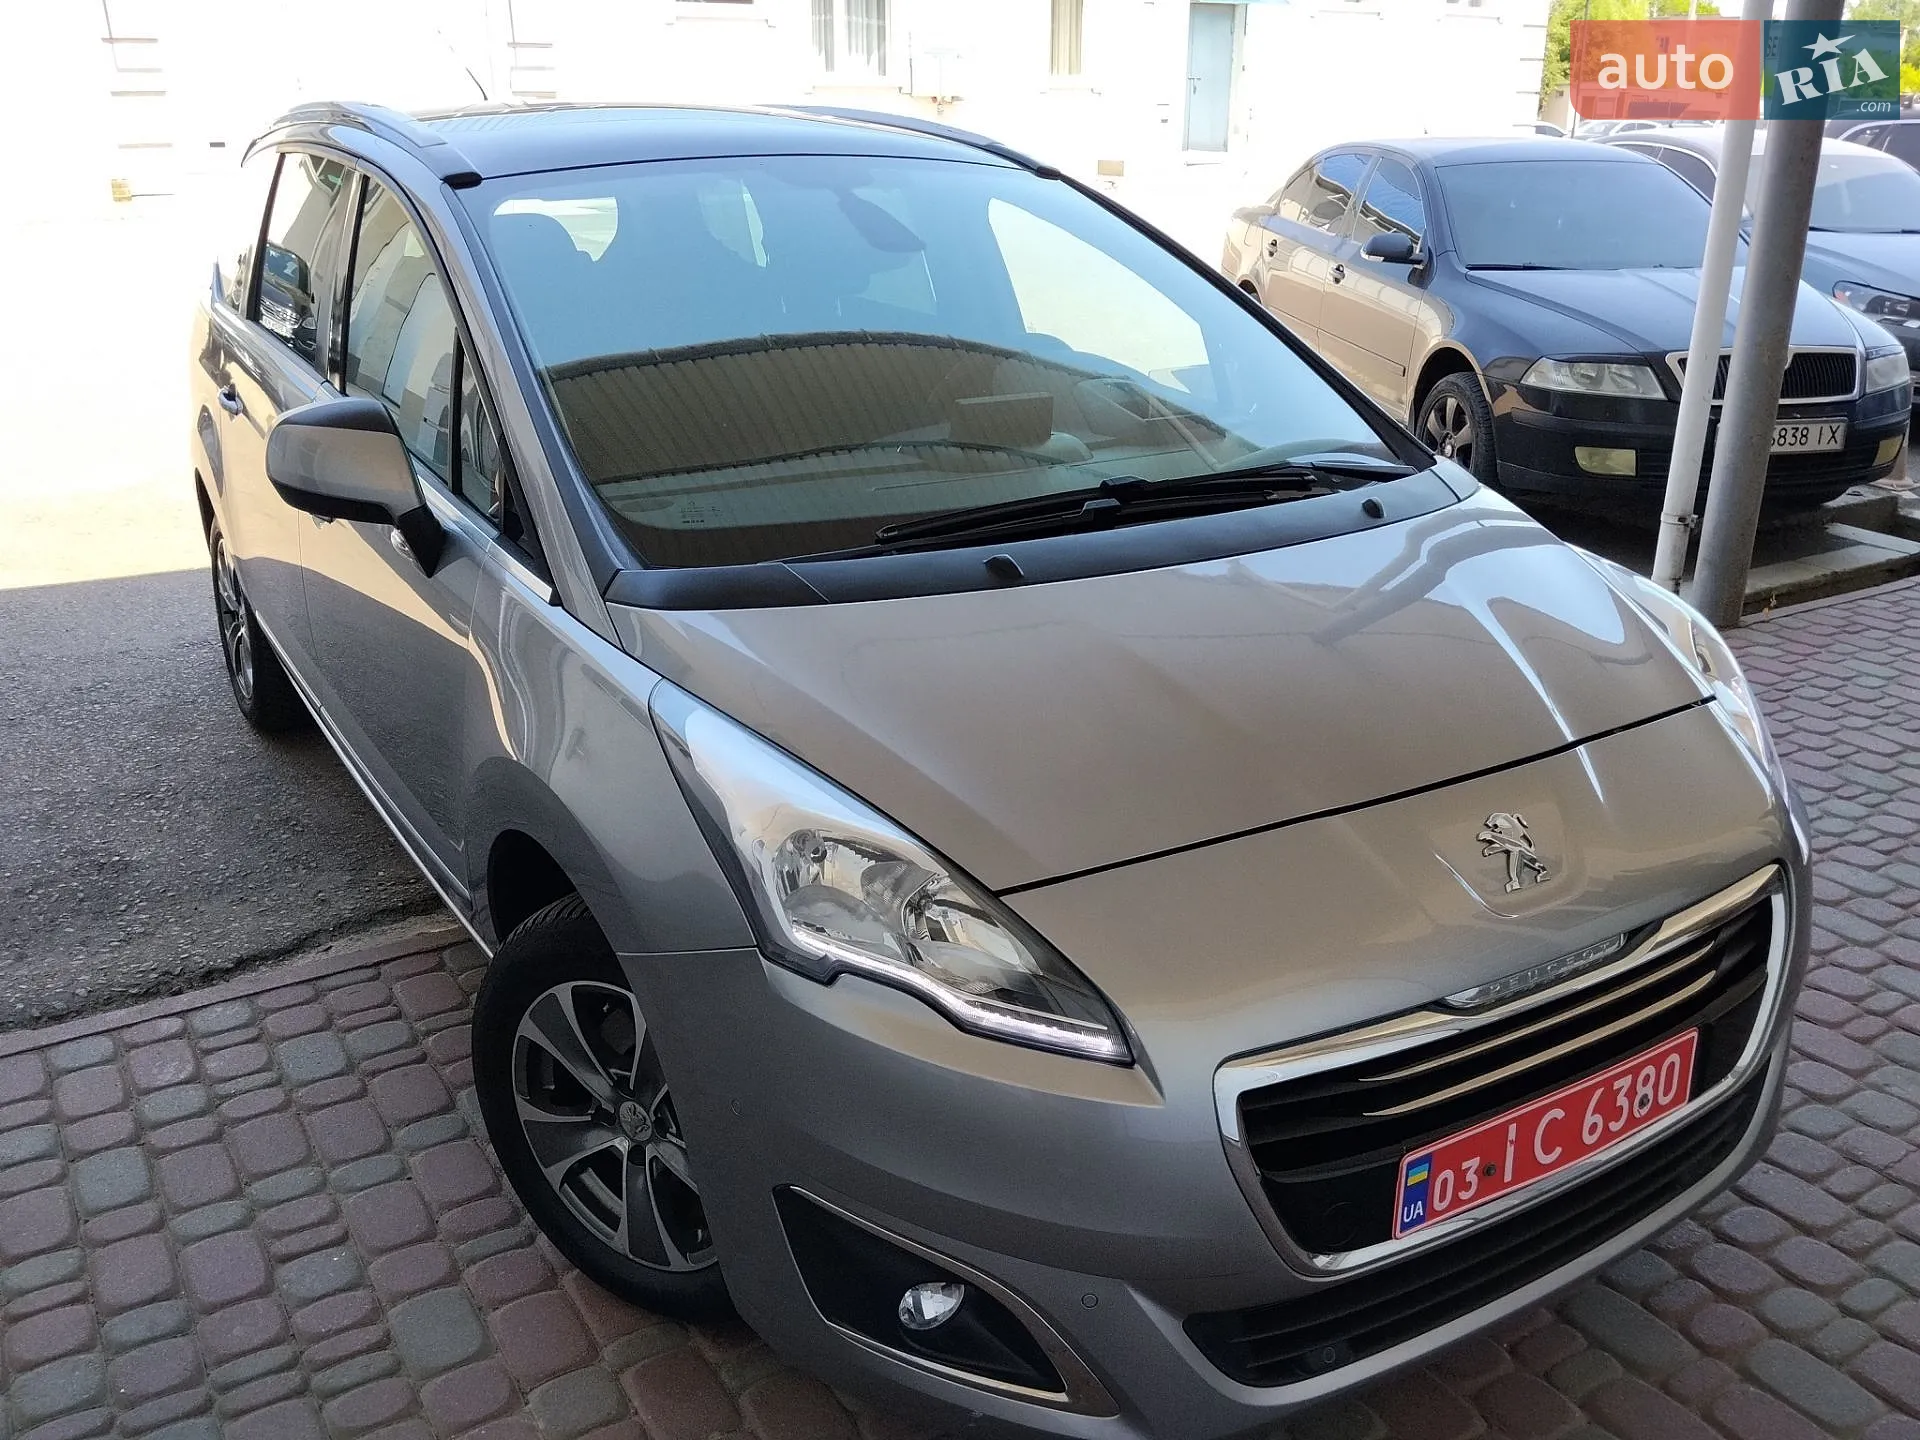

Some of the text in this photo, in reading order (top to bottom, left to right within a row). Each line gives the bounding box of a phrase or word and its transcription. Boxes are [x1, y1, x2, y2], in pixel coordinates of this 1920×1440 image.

[1433, 1157, 1480, 1211] 03
[1582, 1053, 1681, 1146] 6380
[1403, 1202, 1424, 1223] UA
